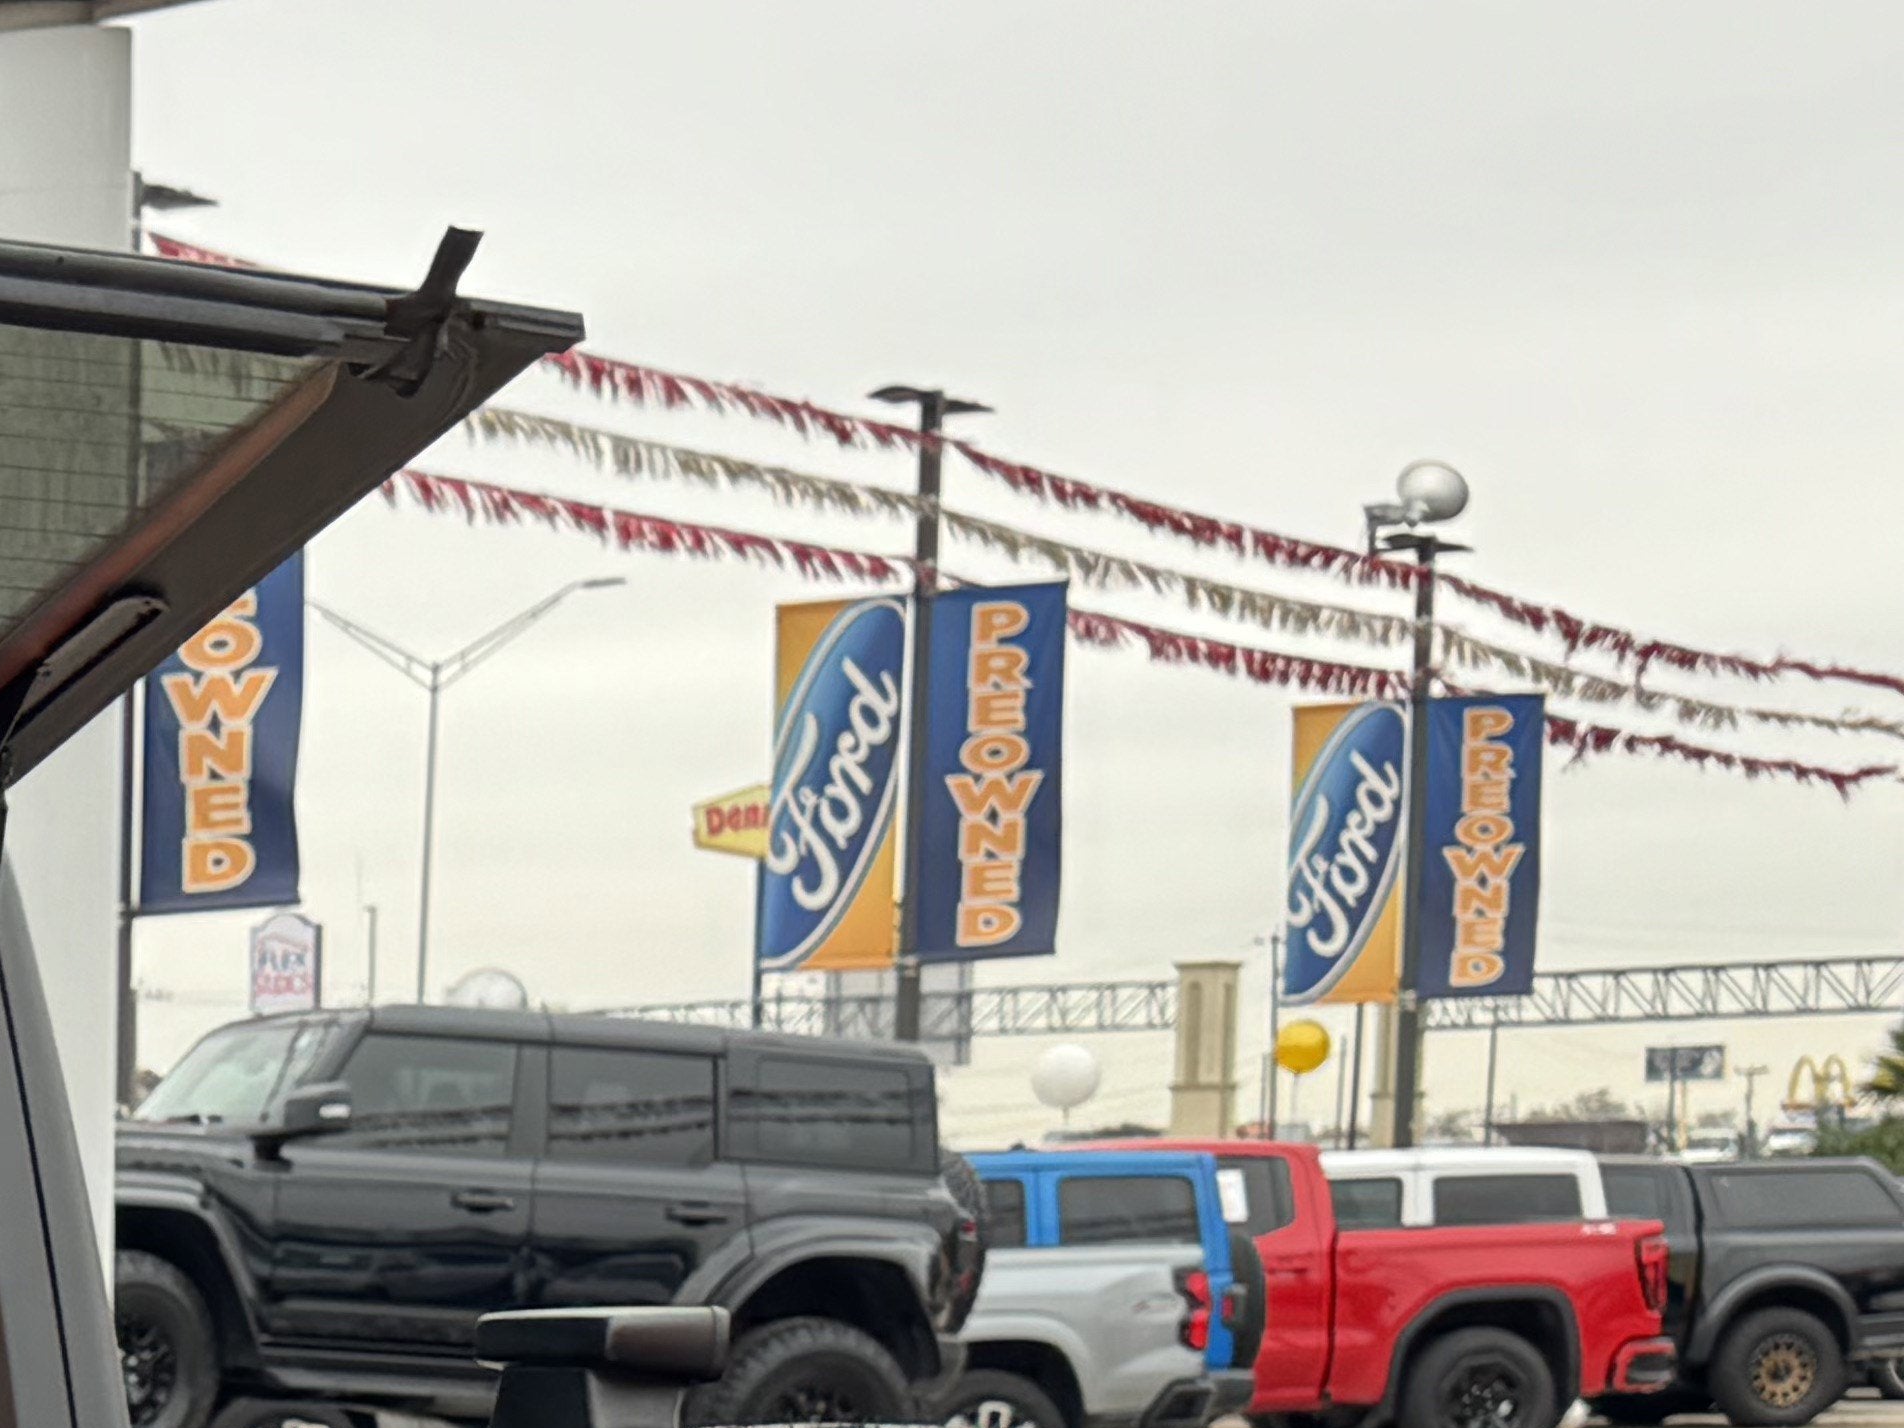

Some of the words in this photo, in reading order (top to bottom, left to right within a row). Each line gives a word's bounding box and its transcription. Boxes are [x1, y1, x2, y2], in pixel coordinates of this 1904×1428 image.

[161, 588, 279, 894] OWNED
[766, 655, 899, 911] Ford
[944, 600, 1044, 948] PREOWNED
[1286, 748, 1401, 959] Ford
[1441, 704, 1526, 989] PREOWNED
